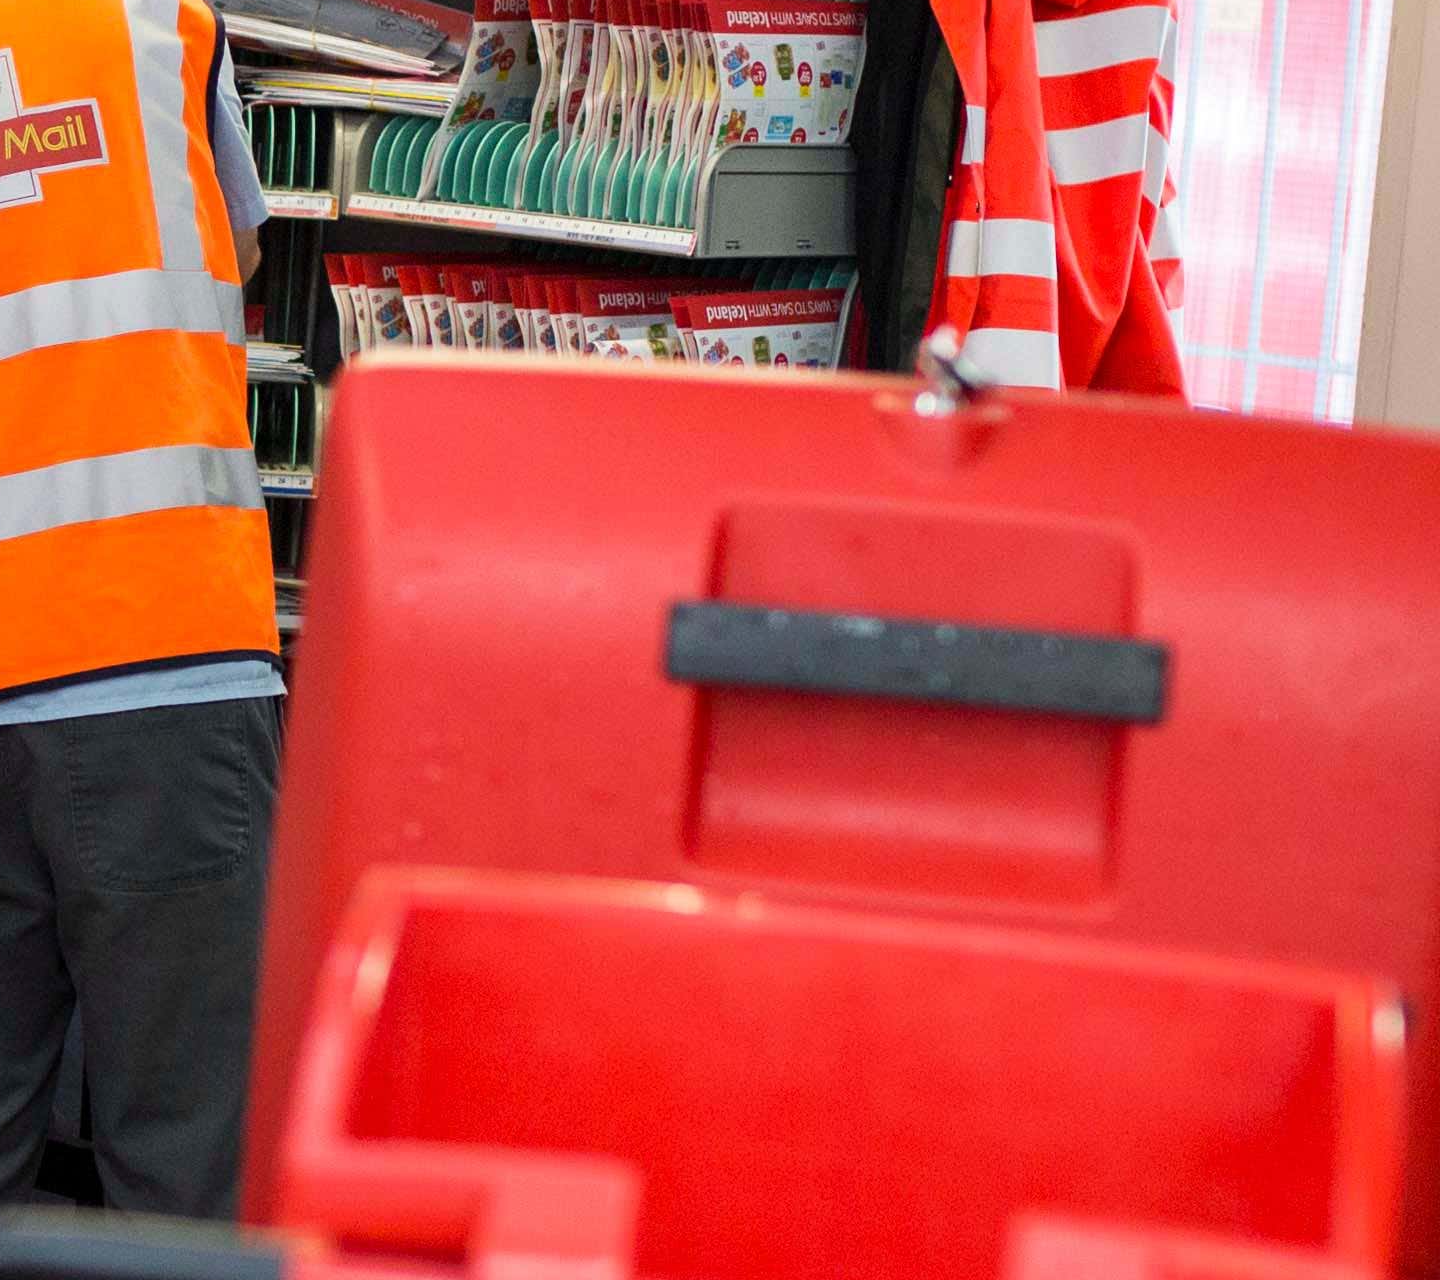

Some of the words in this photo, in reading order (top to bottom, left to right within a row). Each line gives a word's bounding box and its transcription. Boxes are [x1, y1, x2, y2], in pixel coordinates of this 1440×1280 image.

[726, 10, 770, 28] Iceland
[770, 11, 794, 25] WITH
[794, 12, 818, 26] SAVE
[818, 12, 832, 25] TO
[832, 12, 856, 26] WAYS
[3, 115, 88, 160] Mail
[598, 292, 645, 309] Iceland
[794, 300, 807, 314] TO
[807, 299, 832, 313] WAYS
[705, 304, 747, 323] Iceland
[747, 303, 770, 316] WITH
[770, 301, 793, 316] SAVE
